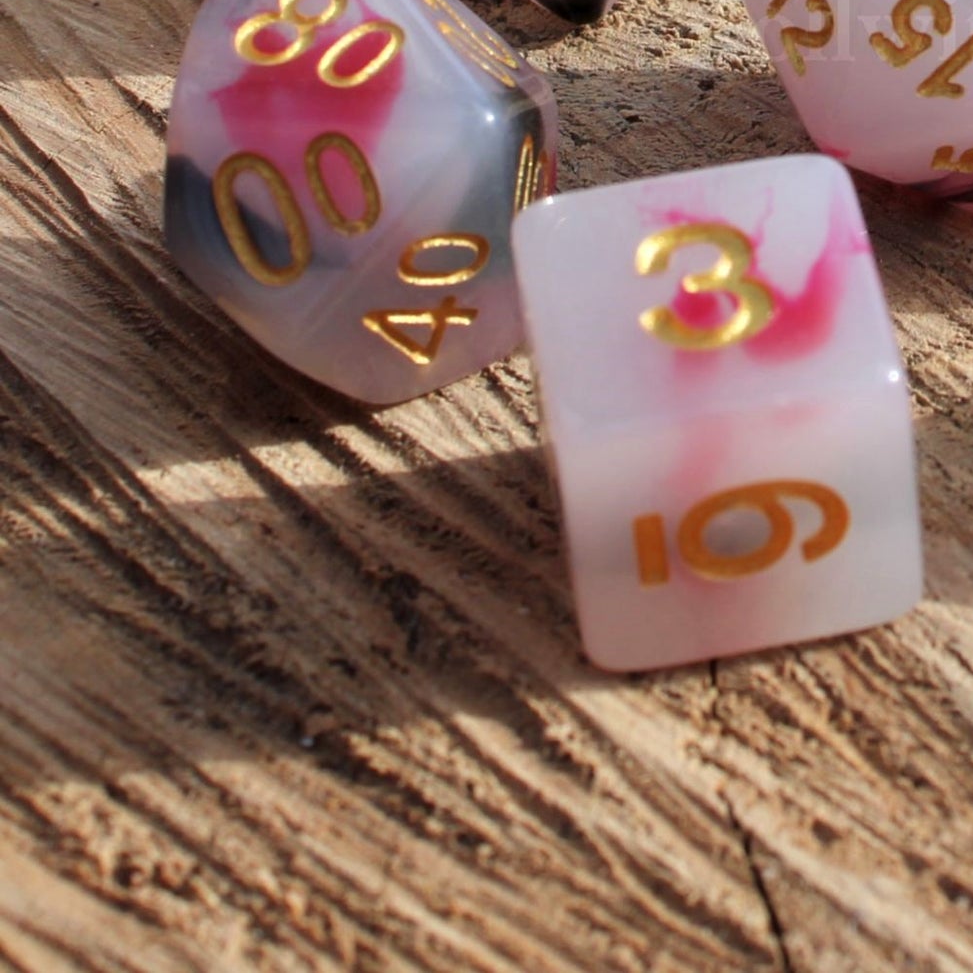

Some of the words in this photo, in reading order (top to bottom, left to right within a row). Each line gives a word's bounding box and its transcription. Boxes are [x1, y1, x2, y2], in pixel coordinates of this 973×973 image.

[213, 132, 382, 287] 00
[361, 233, 490, 365] 40
[634, 222, 774, 350] 3
